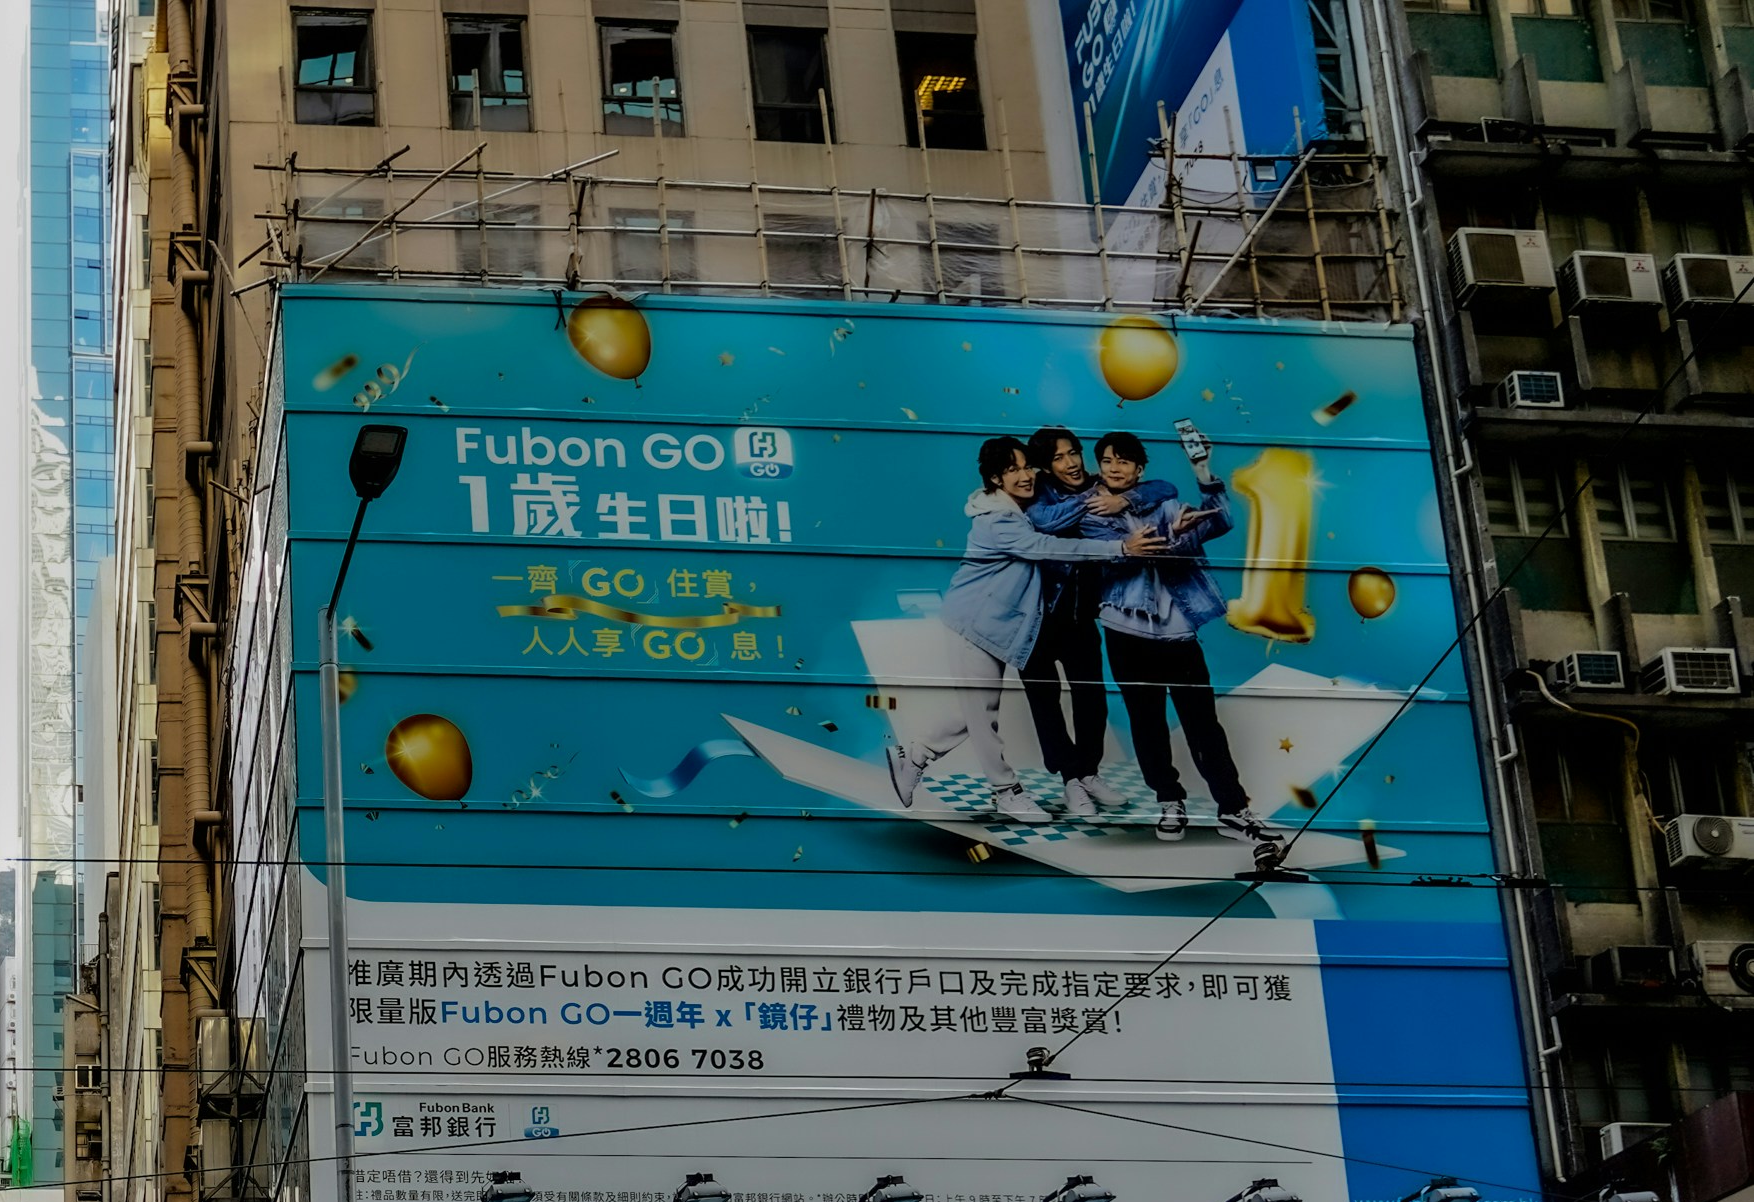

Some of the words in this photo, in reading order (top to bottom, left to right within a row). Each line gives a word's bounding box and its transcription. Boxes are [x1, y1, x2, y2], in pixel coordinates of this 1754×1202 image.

[455, 426, 627, 468] Fubon
[642, 432, 726, 471] GO
[749, 463, 779, 478] GO
[691, 1049, 765, 1070] 7038
[419, 1102, 460, 1113] Fubon
[462, 1102, 495, 1113] Bank
[392, 1116, 496, 1138] 富邦銀行
